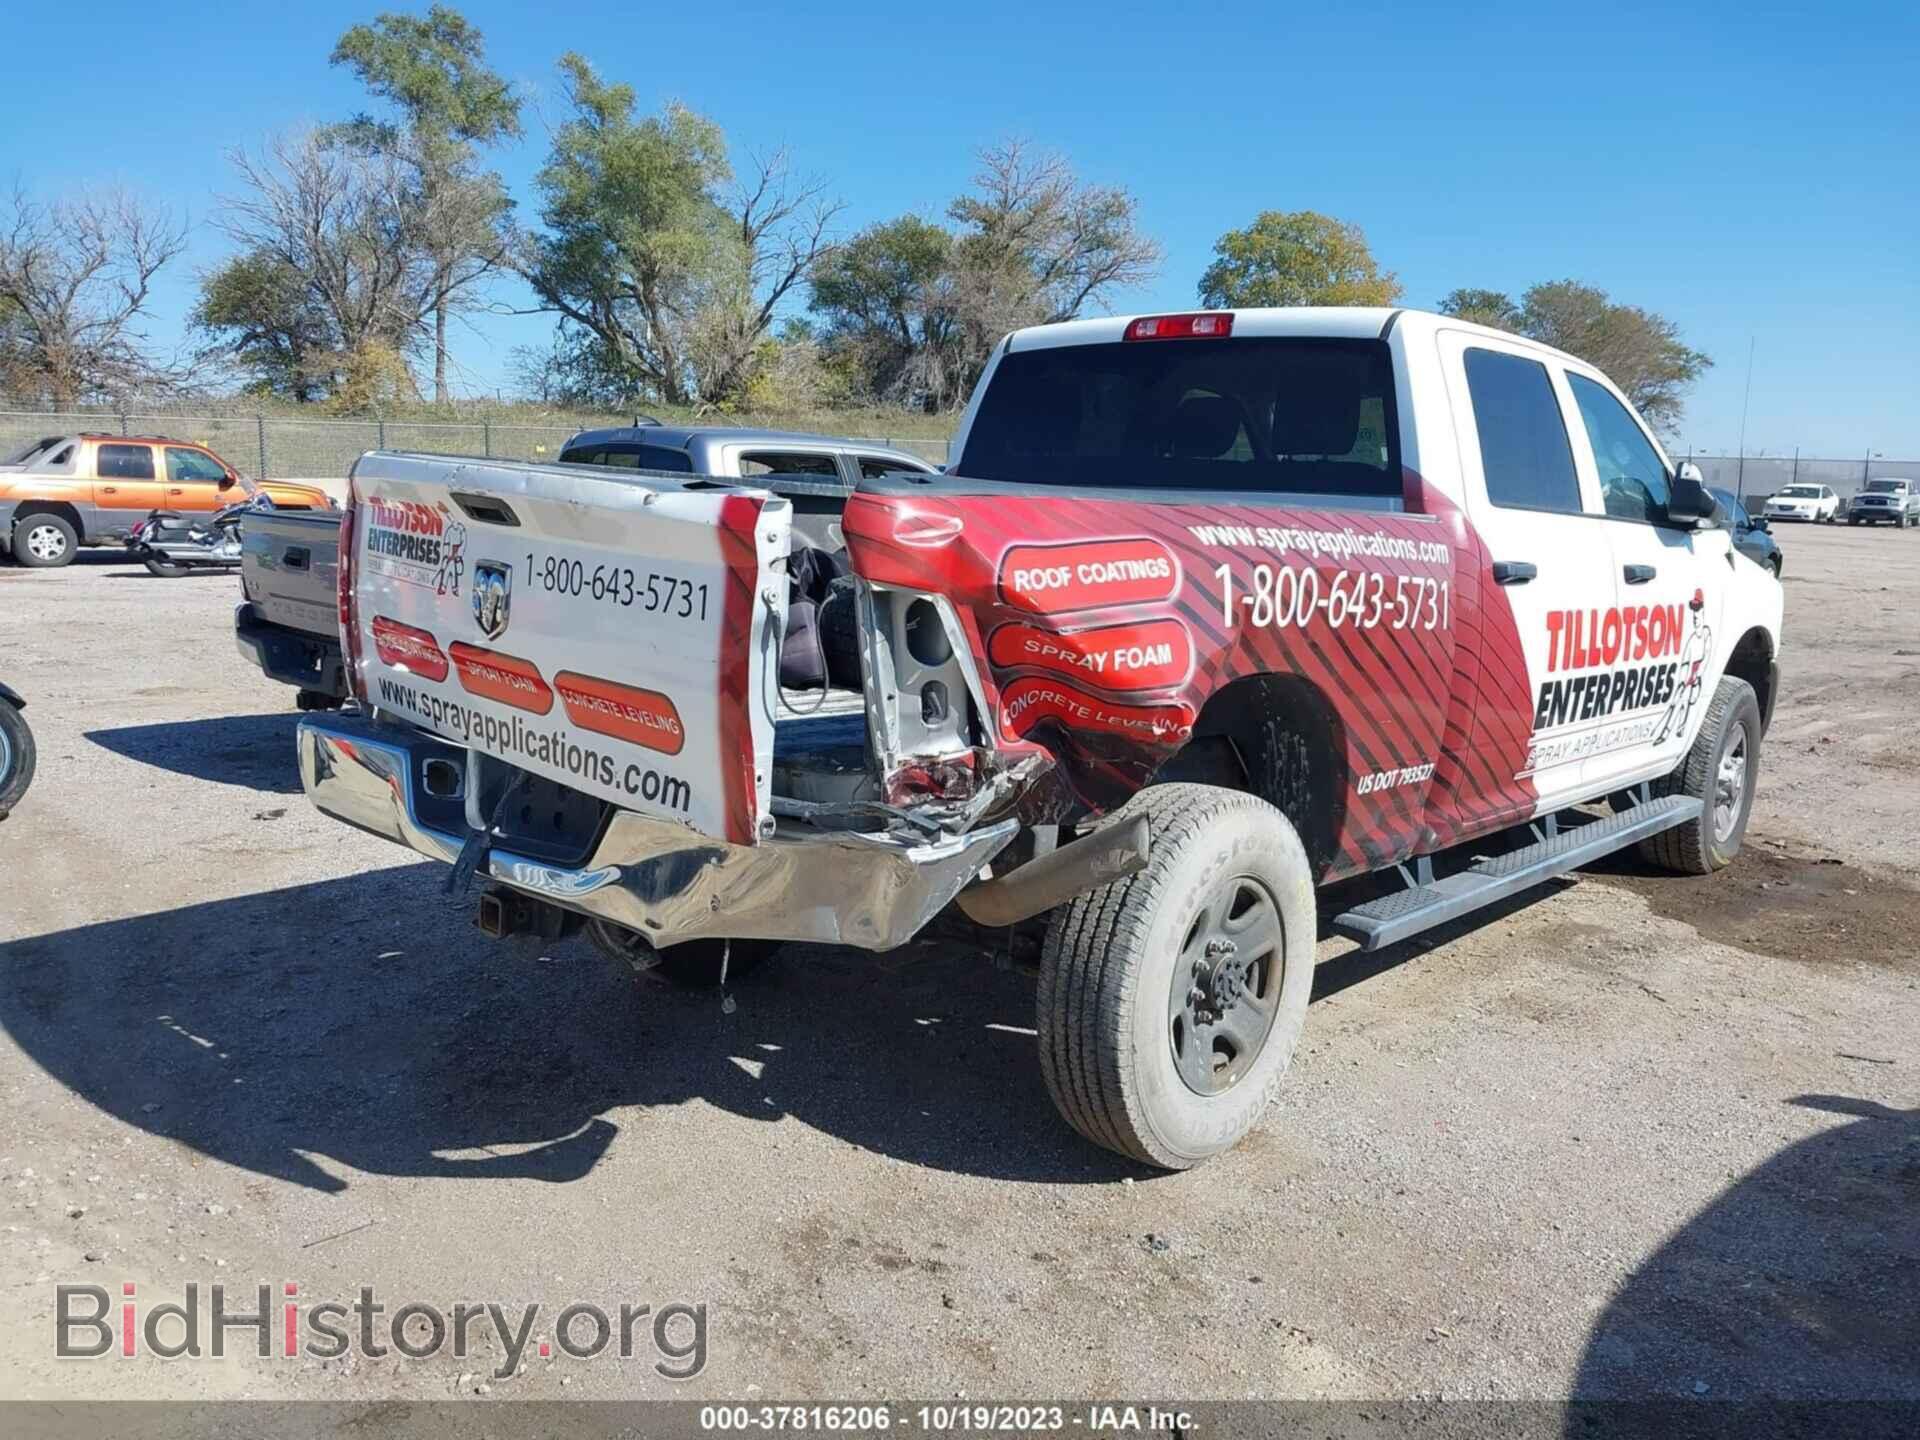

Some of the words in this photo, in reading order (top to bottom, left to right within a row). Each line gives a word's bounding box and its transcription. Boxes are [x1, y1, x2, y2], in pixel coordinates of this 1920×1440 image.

[367, 527, 441, 565] ENTERPRISES
[1188, 526, 1450, 564] www.sprayapplications.com
[527, 553, 708, 621] 1-800-643-5731
[1013, 565, 1072, 592] ROOF
[1077, 558, 1171, 584] COATINGS
[1215, 562, 1449, 631] 1-800-643-5731
[1024, 640, 1110, 672] SPRAY
[1114, 643, 1173, 671] FOAM
[1546, 603, 1685, 672] TILLOTSON
[562, 688, 623, 718] CONCRETE
[621, 704, 680, 735] LEVELING
[1003, 690, 1090, 726] CONCRETE
[1533, 662, 1678, 731] ENTERPRISES
[378, 677, 692, 813] www.sprayapplications.com
[1357, 774, 1375, 795] US
[1372, 769, 1399, 792] DOT
